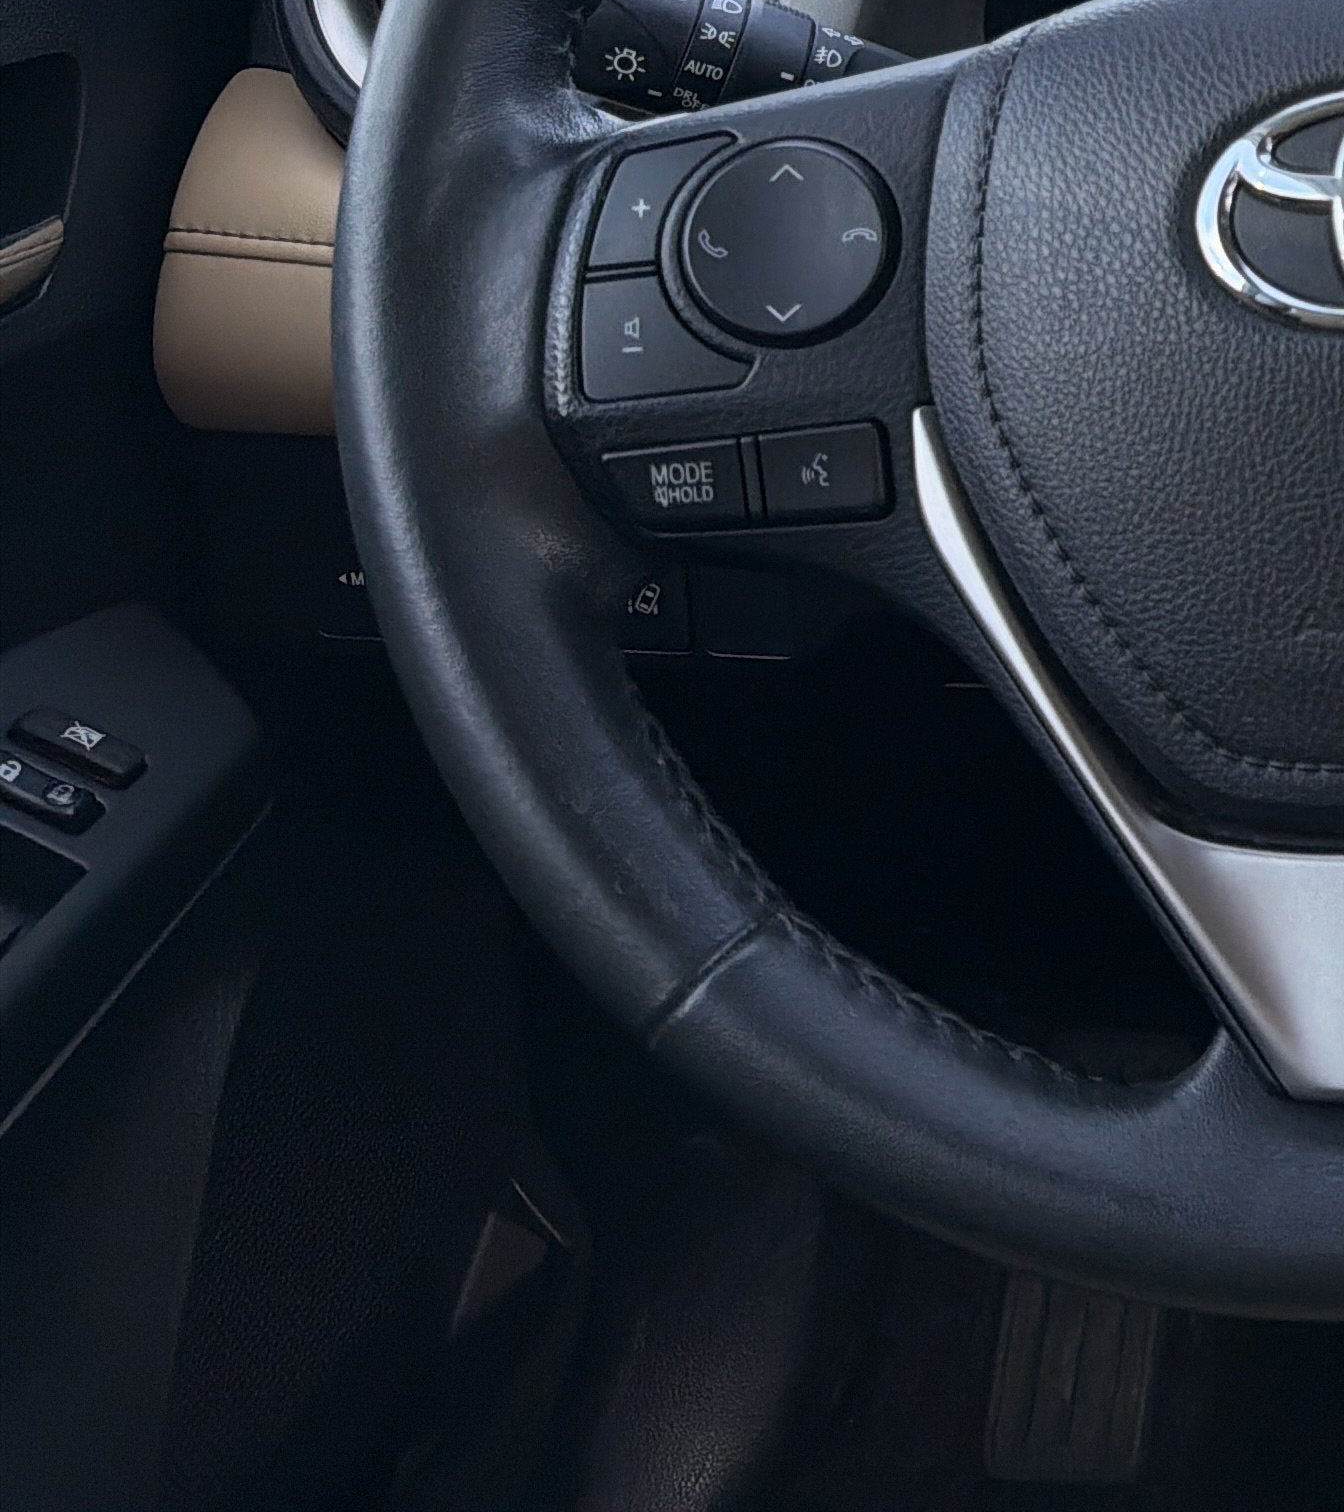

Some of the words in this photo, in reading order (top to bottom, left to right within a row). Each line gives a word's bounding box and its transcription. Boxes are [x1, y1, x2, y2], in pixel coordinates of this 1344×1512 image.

[684, 58, 724, 81] AUTO
[673, 87, 699, 101] DRL
[650, 461, 714, 486] MODE
[669, 485, 714, 504] HOLD
